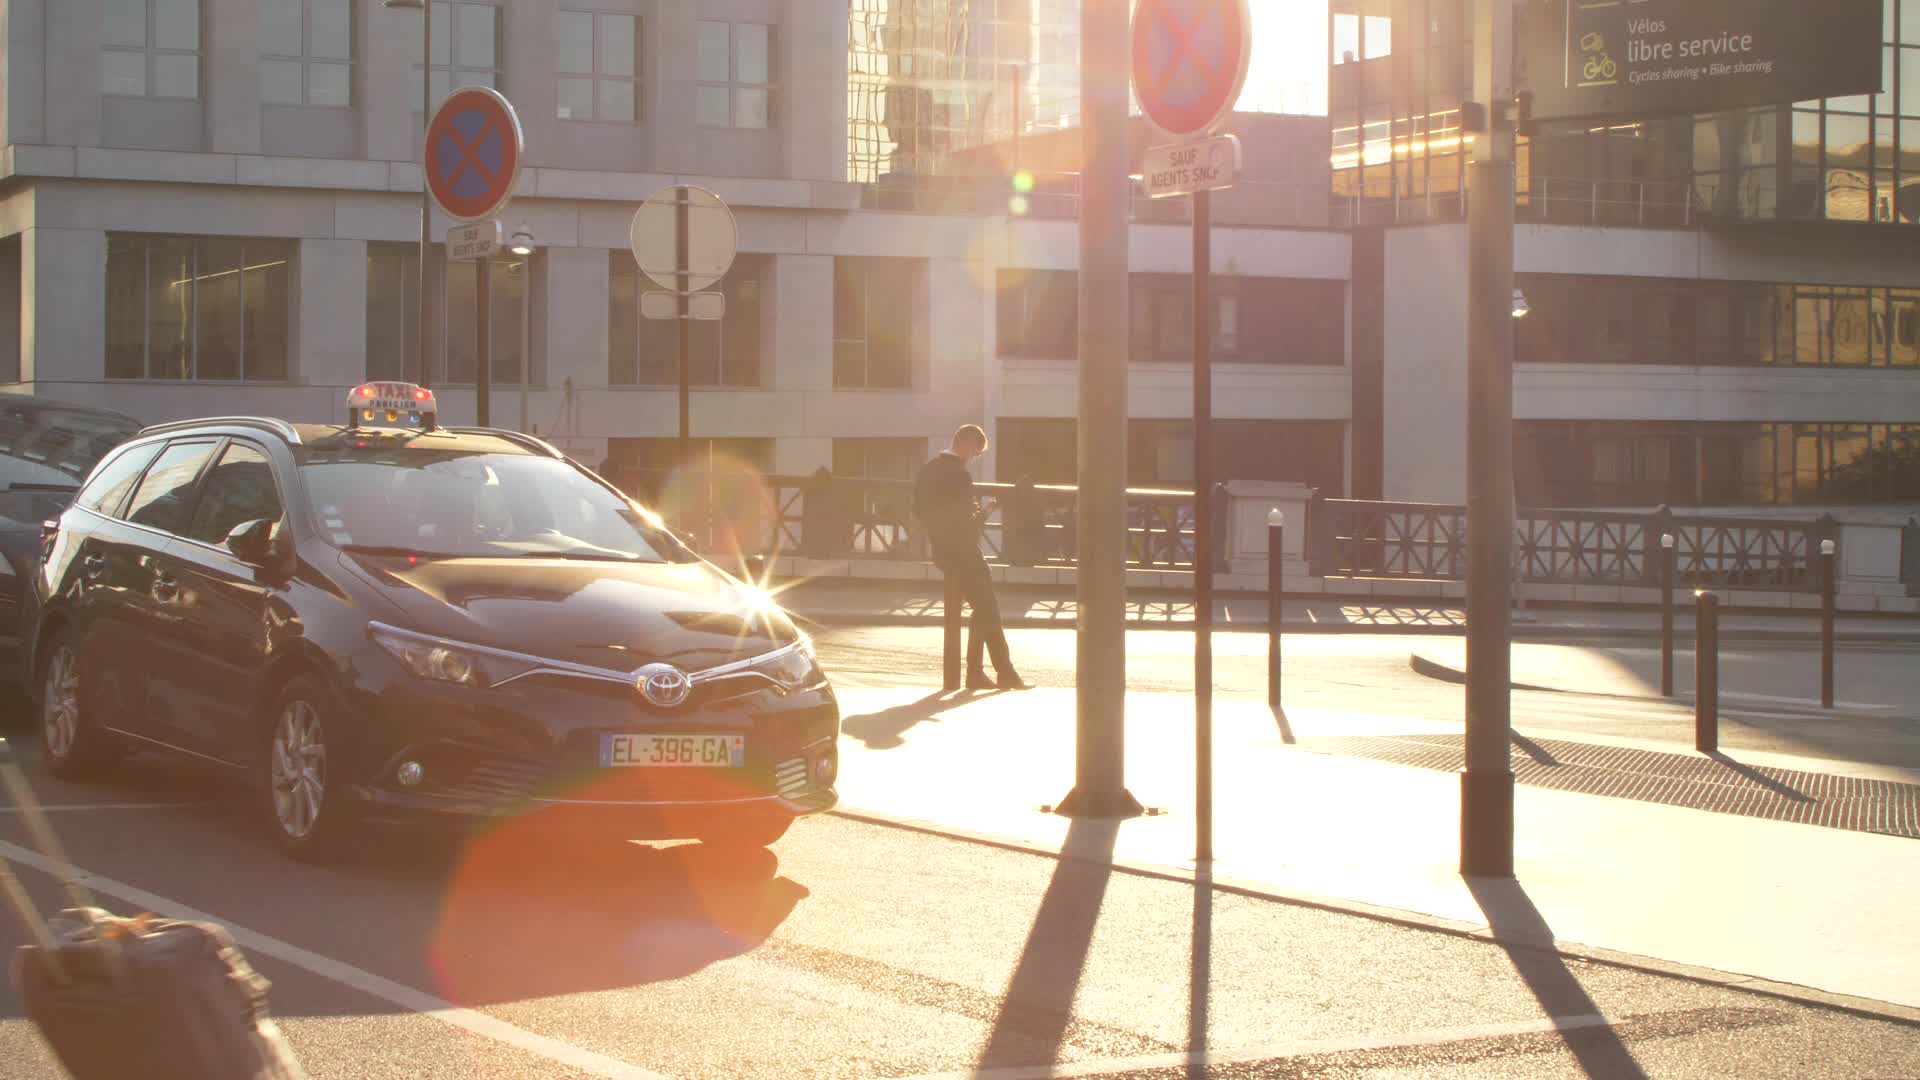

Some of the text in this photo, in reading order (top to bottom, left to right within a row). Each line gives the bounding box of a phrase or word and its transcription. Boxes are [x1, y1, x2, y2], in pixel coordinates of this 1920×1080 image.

[1628, 18, 1666, 35] Vélos
[1627, 32, 1753, 63] libre service
[1629, 59, 1773, 84] Cycles sharing Bike sharing
[1169, 148, 1198, 167] SAUF
[376, 383, 411, 399] TAXI
[613, 737, 729, 764] EL-396-GA
